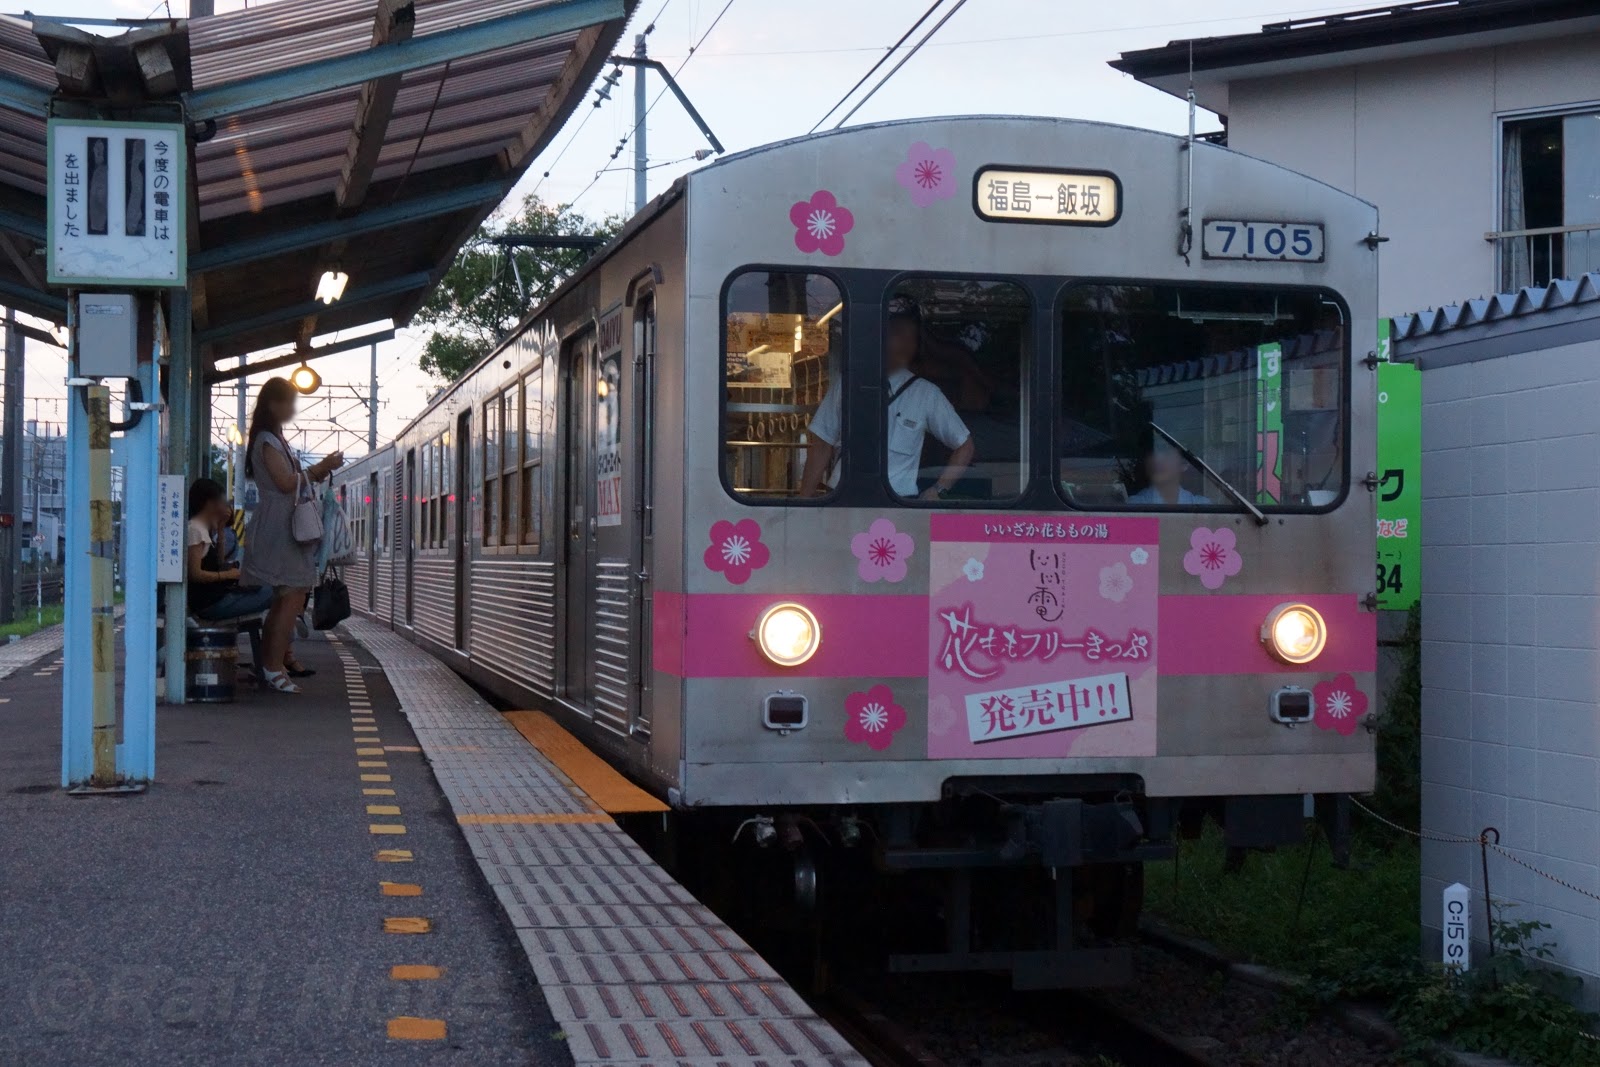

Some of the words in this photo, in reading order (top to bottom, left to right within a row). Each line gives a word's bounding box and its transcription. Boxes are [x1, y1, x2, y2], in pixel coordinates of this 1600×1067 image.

[64, 153, 80, 238] を出ました
[153, 140, 170, 240] 今度の電車は
[987, 179, 1032, 213] 福島
[1057, 182, 1101, 216] 飯坂
[1215, 225, 1313, 255] 7105
[984, 522, 1109, 540] いいざか花ももの湯
[940, 607, 1149, 678] 花ももフリーきっぷ
[979, 683, 1119, 736] 発売中!!
